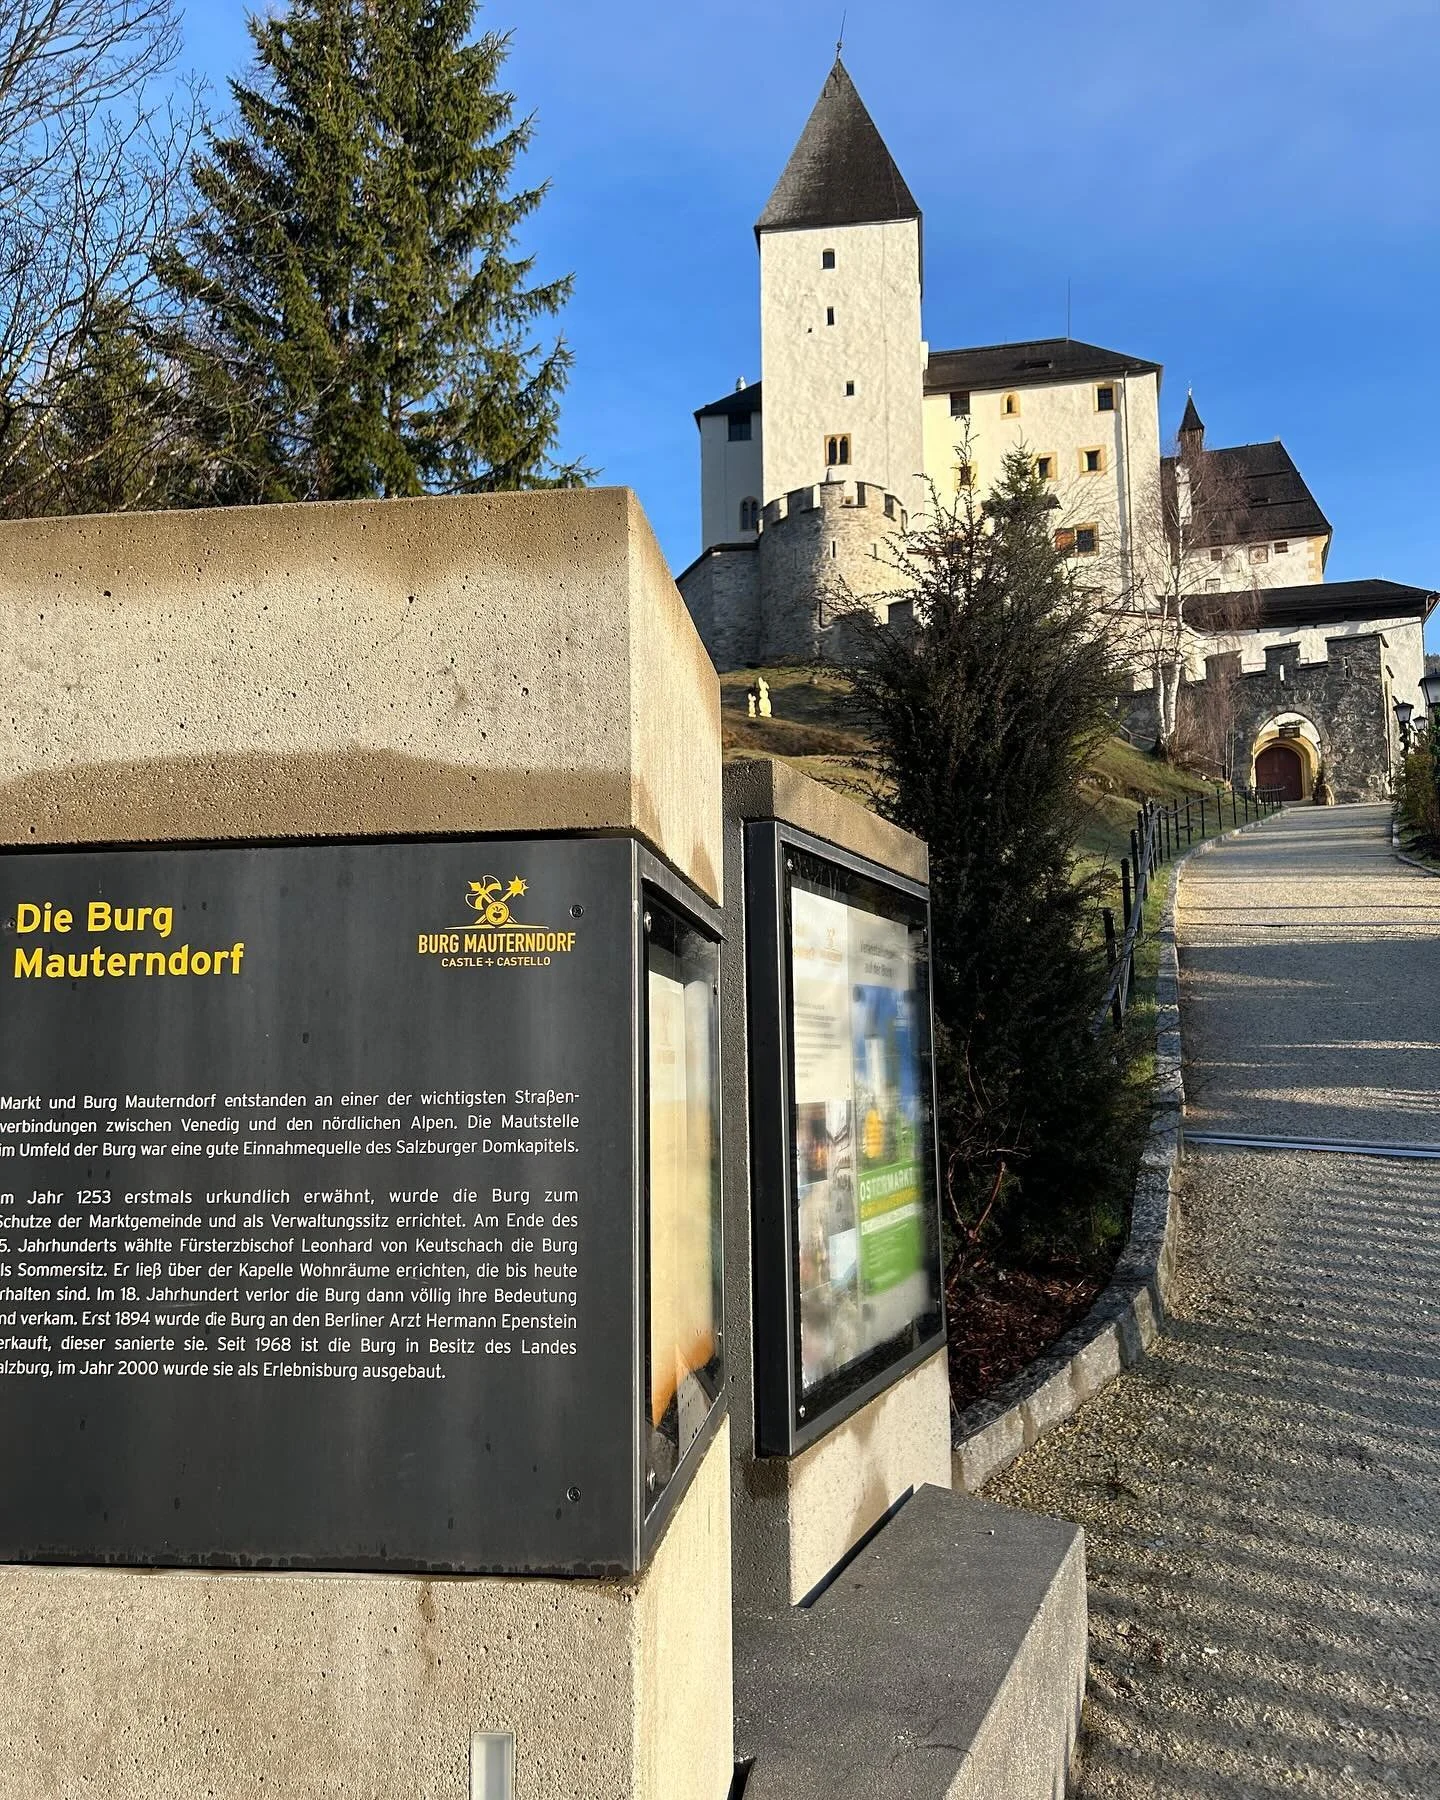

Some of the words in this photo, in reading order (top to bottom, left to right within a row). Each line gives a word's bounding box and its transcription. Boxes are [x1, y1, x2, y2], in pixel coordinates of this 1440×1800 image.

[16, 902, 73, 933] Die
[87, 901, 173, 938] Burg
[418, 934, 460, 954] BURG
[464, 932, 577, 953] MAUTERNDORF
[14, 943, 245, 978] Mauterndorf
[441, 957, 484, 968] CASTLE
[496, 956, 551, 967] CASTELLO
[1, 1096, 42, 1110] Markt
[48, 1096, 76, 1110] und
[83, 1096, 118, 1112] Burg
[125, 1094, 217, 1109] Mauterndorf
[224, 1093, 307, 1108] entstanden
[314, 1096, 333, 1107] an
[340, 1092, 380, 1107] einer
[387, 1092, 413, 1106] der
[420, 1090, 506, 1108] wichtigsten
[514, 1090, 580, 1107] Straßen-
[0, 1119, 97, 1136] verbindungen
[105, 1118, 172, 1133] zwischen
[180, 1117, 240, 1135] Venedig
[248, 1117, 277, 1131] und
[286, 1117, 313, 1131] den
[322, 1116, 401, 1131] nördlichen
[410, 1116, 458, 1133] Alpen.
[467, 1115, 492, 1129] Die
[501, 1114, 580, 1129] Mautstelle
[19, 1143, 71, 1157] Umfeld
[73, 1143, 99, 1157] der
[102, 1143, 137, 1160] Burg
[140, 1145, 168, 1156] war
[170, 1142, 202, 1156] eine
[205, 1142, 239, 1159] gute
[243, 1141, 362, 1158] Einnahmequelle
[365, 1140, 392, 1155] des
[395, 1140, 478, 1157] Salzburger
[482, 1138, 579, 1156] Domkapitels.
[26, 1191, 65, 1205] Jahr
[76, 1190, 112, 1205] 1253
[124, 1190, 193, 1204] erstmals
[206, 1189, 290, 1204] urkundlich
[303, 1189, 375, 1205] erwähnt,
[388, 1189, 439, 1203] wurde
[452, 1188, 478, 1203] die
[492, 1189, 530, 1206] Burg
[544, 1191, 579, 1203] zum
[57, 1214, 83, 1229] der
[89, 1214, 202, 1232] Marktgemeinde
[208, 1214, 237, 1228] und
[242, 1214, 264, 1228] als
[270, 1213, 390, 1232] Verwaltungssitz
[396, 1213, 466, 1228] errichtet.
[473, 1214, 499, 1228] Am
[506, 1213, 545, 1228] Ende
[551, 1213, 579, 1228] des
[17, 1238, 117, 1253] Jahrhunderts
[123, 1238, 173, 1253] wählte
[179, 1238, 295, 1253] Fürsterzbischof
[301, 1238, 373, 1253] Leonhard
[380, 1241, 408, 1253] von
[415, 1238, 503, 1253] Keutschach
[510, 1238, 534, 1253] die
[542, 1238, 578, 1256] Burg
[17, 1262, 108, 1277] Sommersitz.
[113, 1263, 131, 1277] Er
[135, 1262, 162, 1280] ließ
[167, 1263, 203, 1277] über
[207, 1263, 233, 1278] der
[238, 1263, 294, 1280] Kapelle
[299, 1263, 390, 1278] Wohnräume
[396, 1263, 470, 1280] errichten,
[476, 1263, 500, 1278] die
[505, 1263, 527, 1278] bis
[534, 1264, 578, 1278] heute
[56, 1286, 91, 1301] sind.
[96, 1287, 115, 1301] Im
[120, 1287, 141, 1302] 18.
[145, 1287, 240, 1302] Jahrhundert
[245, 1288, 290, 1302] verlor
[295, 1288, 319, 1302] die
[324, 1288, 360, 1306] Burg
[366, 1288, 404, 1303] dann
[410, 1288, 451, 1306] völlig
[457, 1288, 488, 1303] ihre
[494, 1288, 577, 1307] Bedeutung
[20, 1311, 78, 1326] verkam.
[81, 1311, 112, 1326] Erst
[114, 1312, 151, 1326] 1894
[154, 1312, 200, 1327] wurde
[204, 1312, 227, 1327] die
[230, 1312, 266, 1330] Burg
[269, 1316, 288, 1327] an
[292, 1313, 320, 1327] den
[324, 1313, 385, 1328] Berliner
[388, 1313, 422, 1328] Arzt
[426, 1313, 497, 1329] Hermann
[501, 1314, 577, 1332] Epenstein
[60, 1336, 107, 1351] dieser
[113, 1336, 175, 1351] sanierte
[183, 1336, 209, 1351] sie.
[217, 1337, 247, 1352] Seit
[254, 1337, 292, 1352] 1968
[300, 1337, 319, 1353] ist
[327, 1338, 351, 1353] die
[360, 1338, 396, 1357] Burg
[405, 1338, 419, 1353] in
[429, 1338, 476, 1354] Besitz
[484, 1339, 512, 1354] des
[521, 1339, 577, 1355] Landes
[57, 1360, 76, 1375] im
[78, 1361, 115, 1375] Jahr
[117, 1361, 159, 1376] 2000
[162, 1361, 209, 1376] wurde
[212, 1361, 234, 1377] sie
[237, 1362, 259, 1377] als
[263, 1362, 358, 1381] Erlebnisburg
[362, 1364, 446, 1383] ausgebaut.
